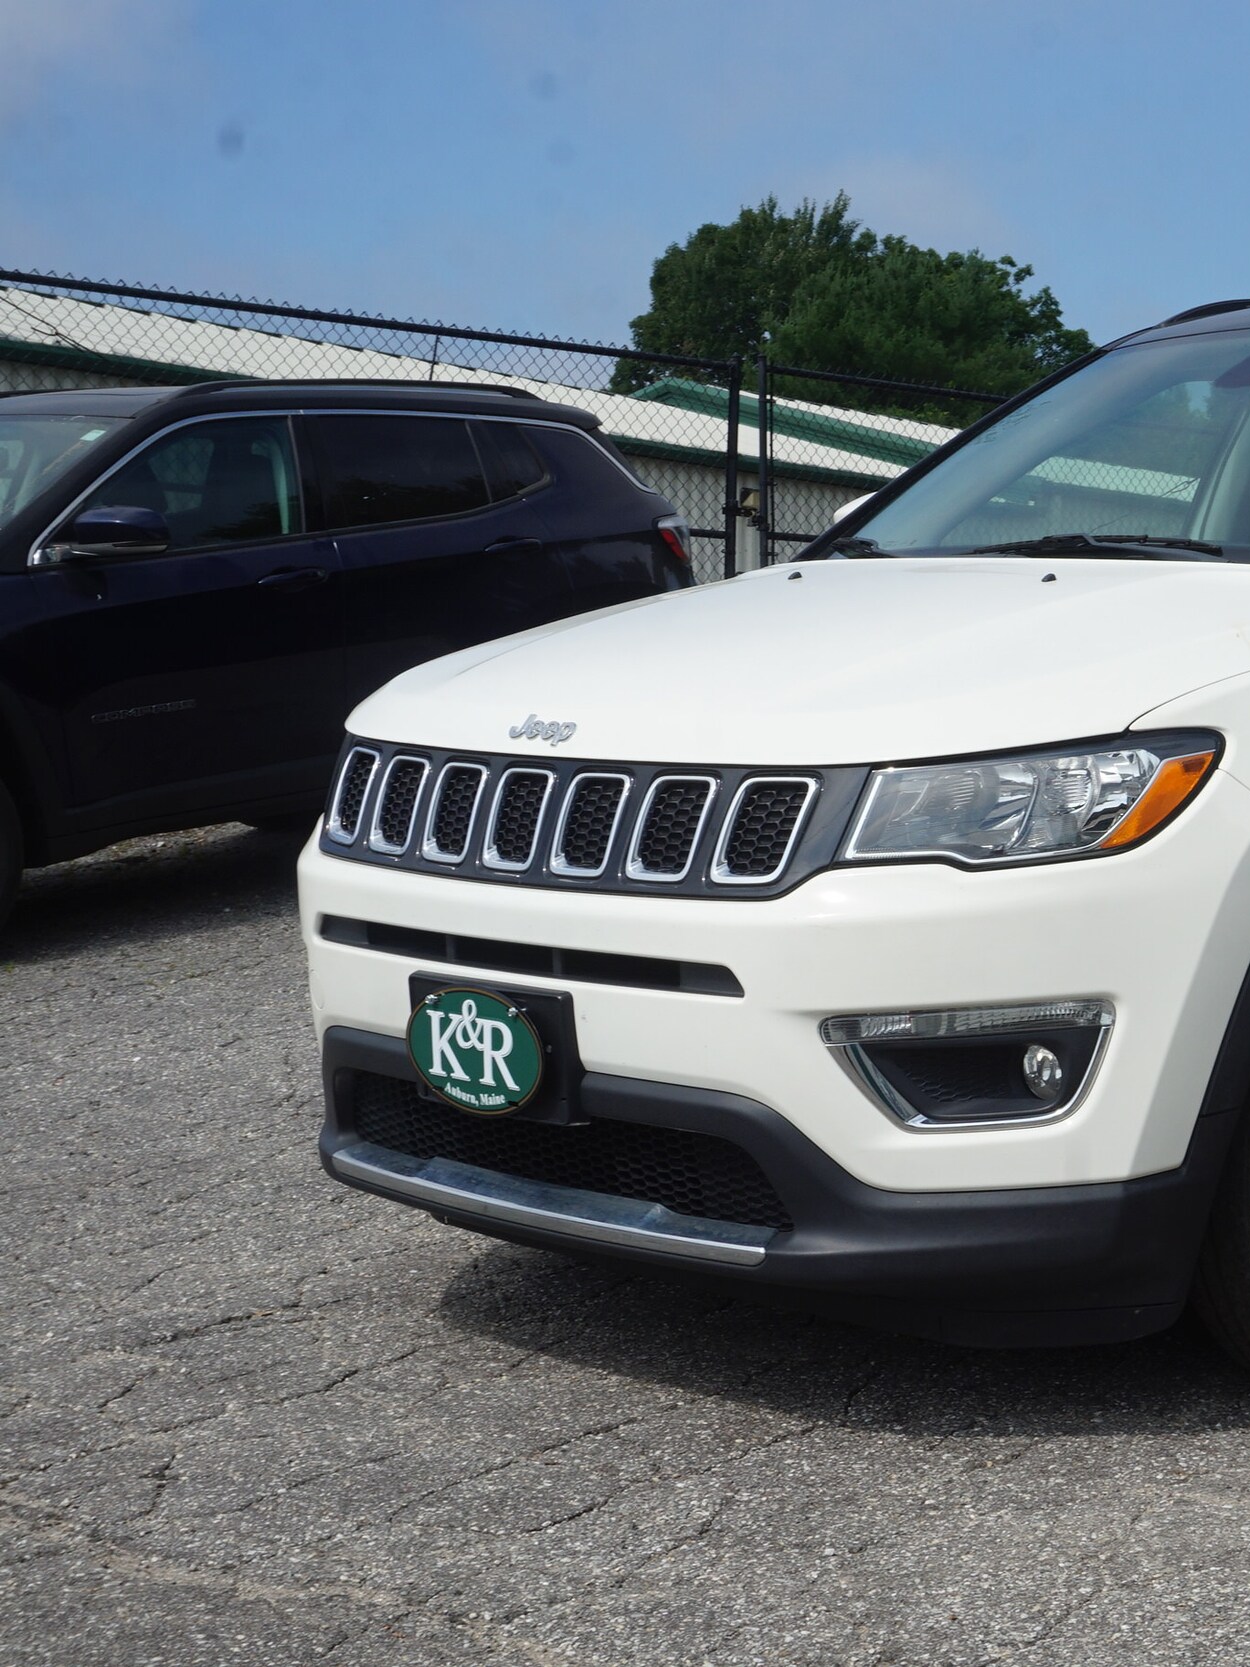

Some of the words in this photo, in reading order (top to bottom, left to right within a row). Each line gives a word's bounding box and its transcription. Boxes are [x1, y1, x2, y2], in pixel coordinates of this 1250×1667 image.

[508, 713, 577, 747] Jeep
[426, 999, 520, 1091] K&R
[444, 1082, 479, 1107] Auburn,
[480, 1093, 505, 1106] Maine
